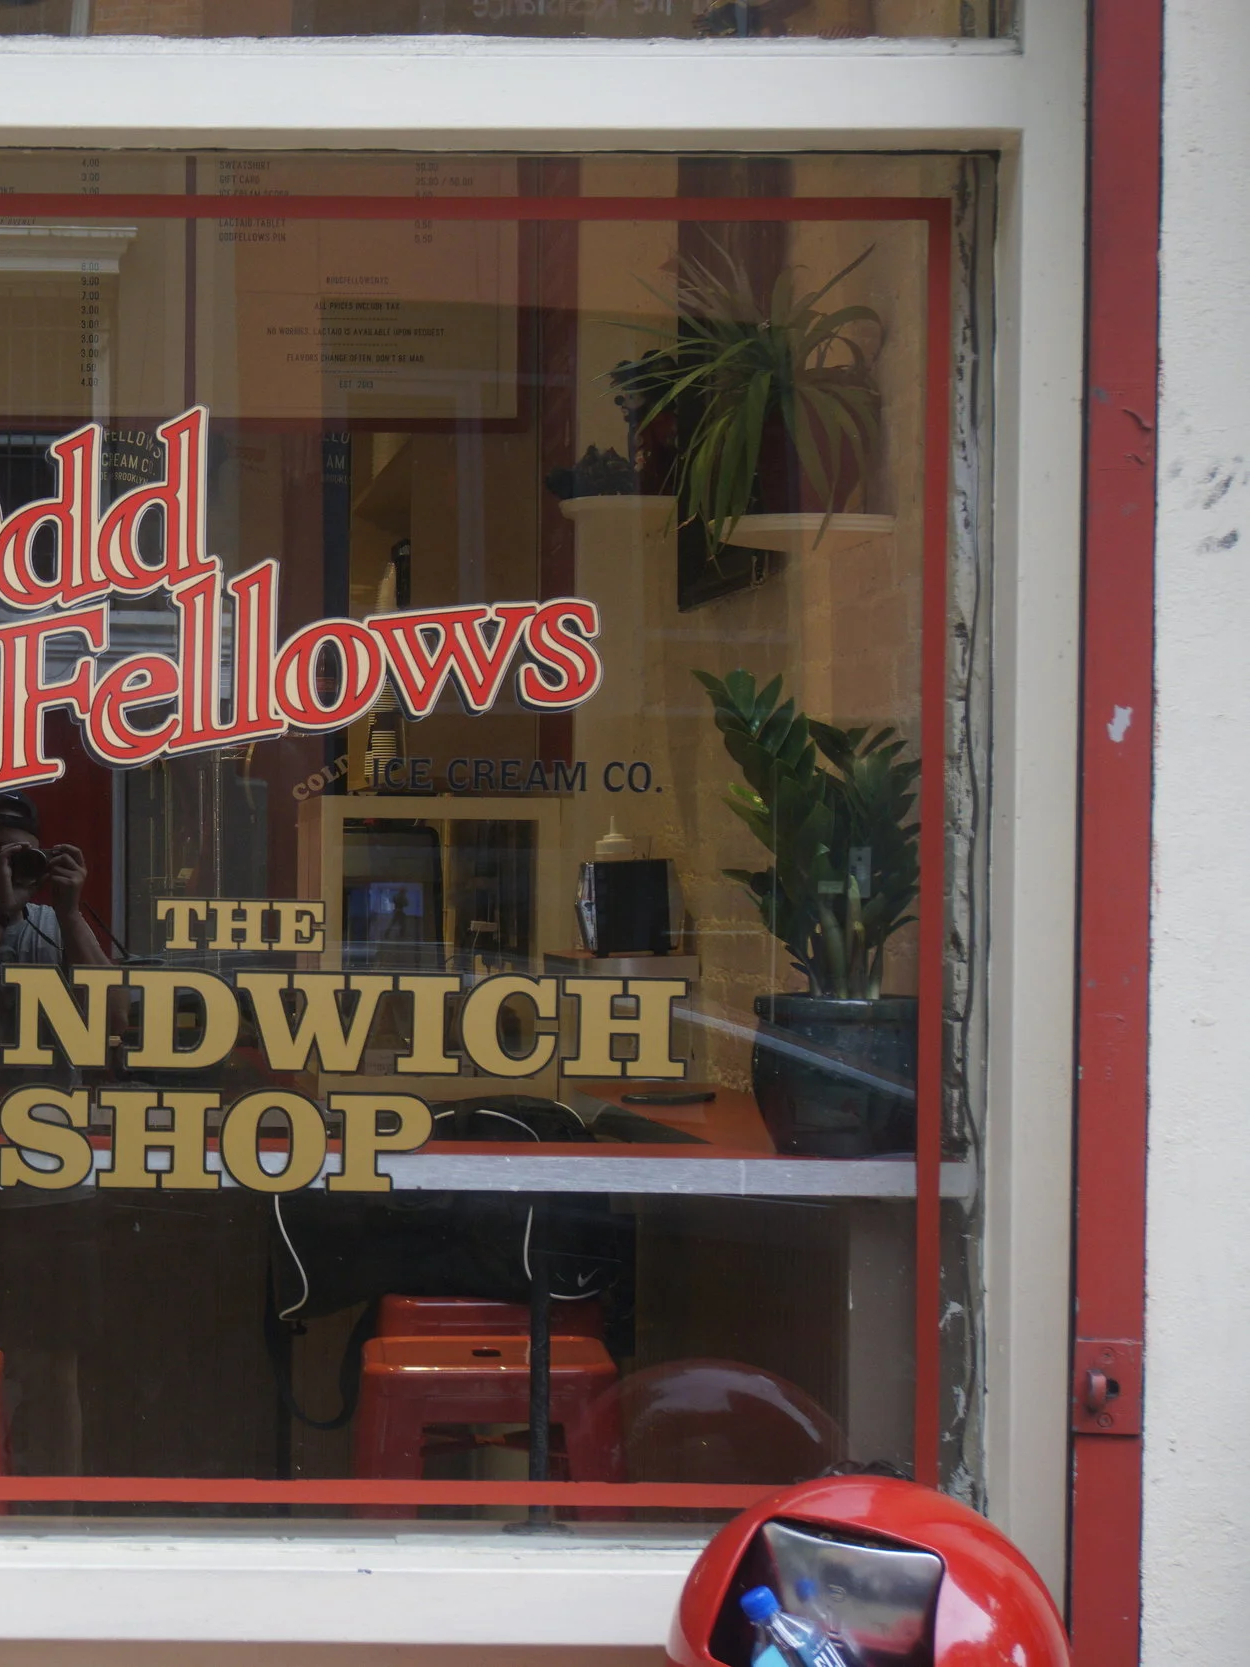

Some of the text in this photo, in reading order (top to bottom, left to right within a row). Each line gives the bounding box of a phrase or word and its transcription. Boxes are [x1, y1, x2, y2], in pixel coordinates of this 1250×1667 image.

[372, 756, 664, 795] ICE CREAM CO.
[155, 898, 327, 953] THE
